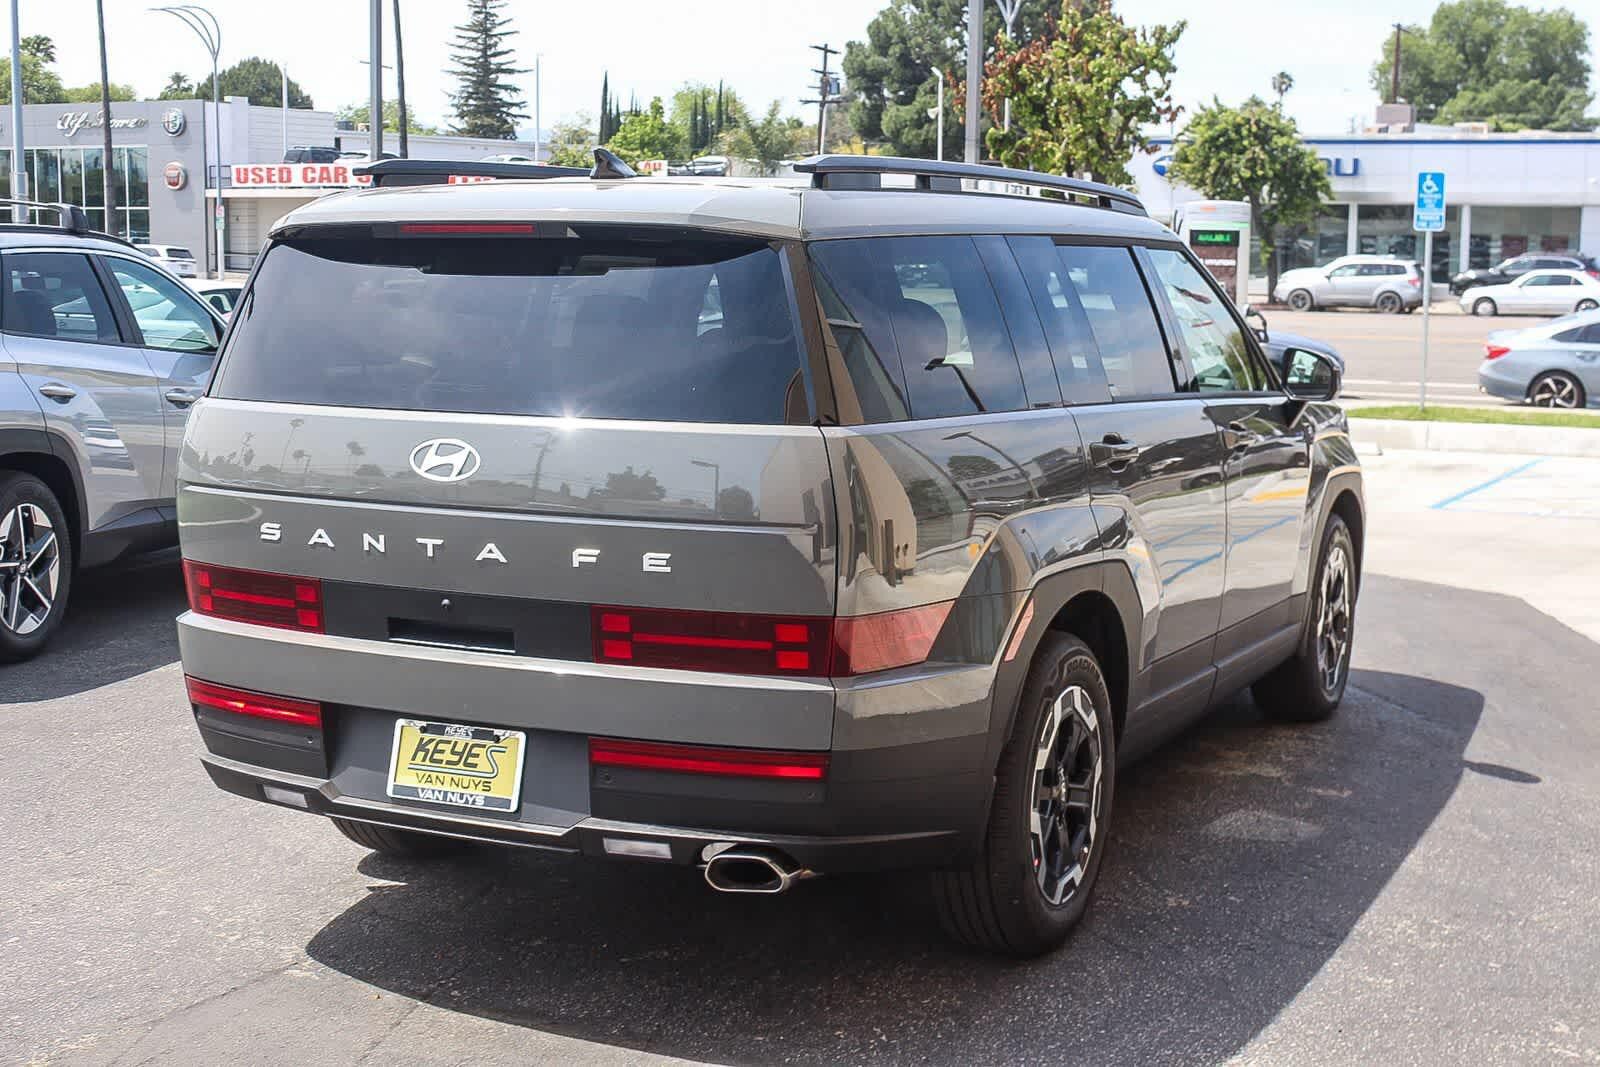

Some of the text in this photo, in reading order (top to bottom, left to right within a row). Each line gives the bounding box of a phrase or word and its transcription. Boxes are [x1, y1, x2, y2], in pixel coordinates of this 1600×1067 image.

[235, 166, 292, 184] USED
[302, 166, 348, 184] CAR
[260, 522, 672, 573] SANTA FE
[444, 726, 475, 739] KEYES
[408, 737, 508, 776] KEYES
[415, 772, 492, 792] VAN NUYS
[417, 788, 485, 806] VAN NUYS
